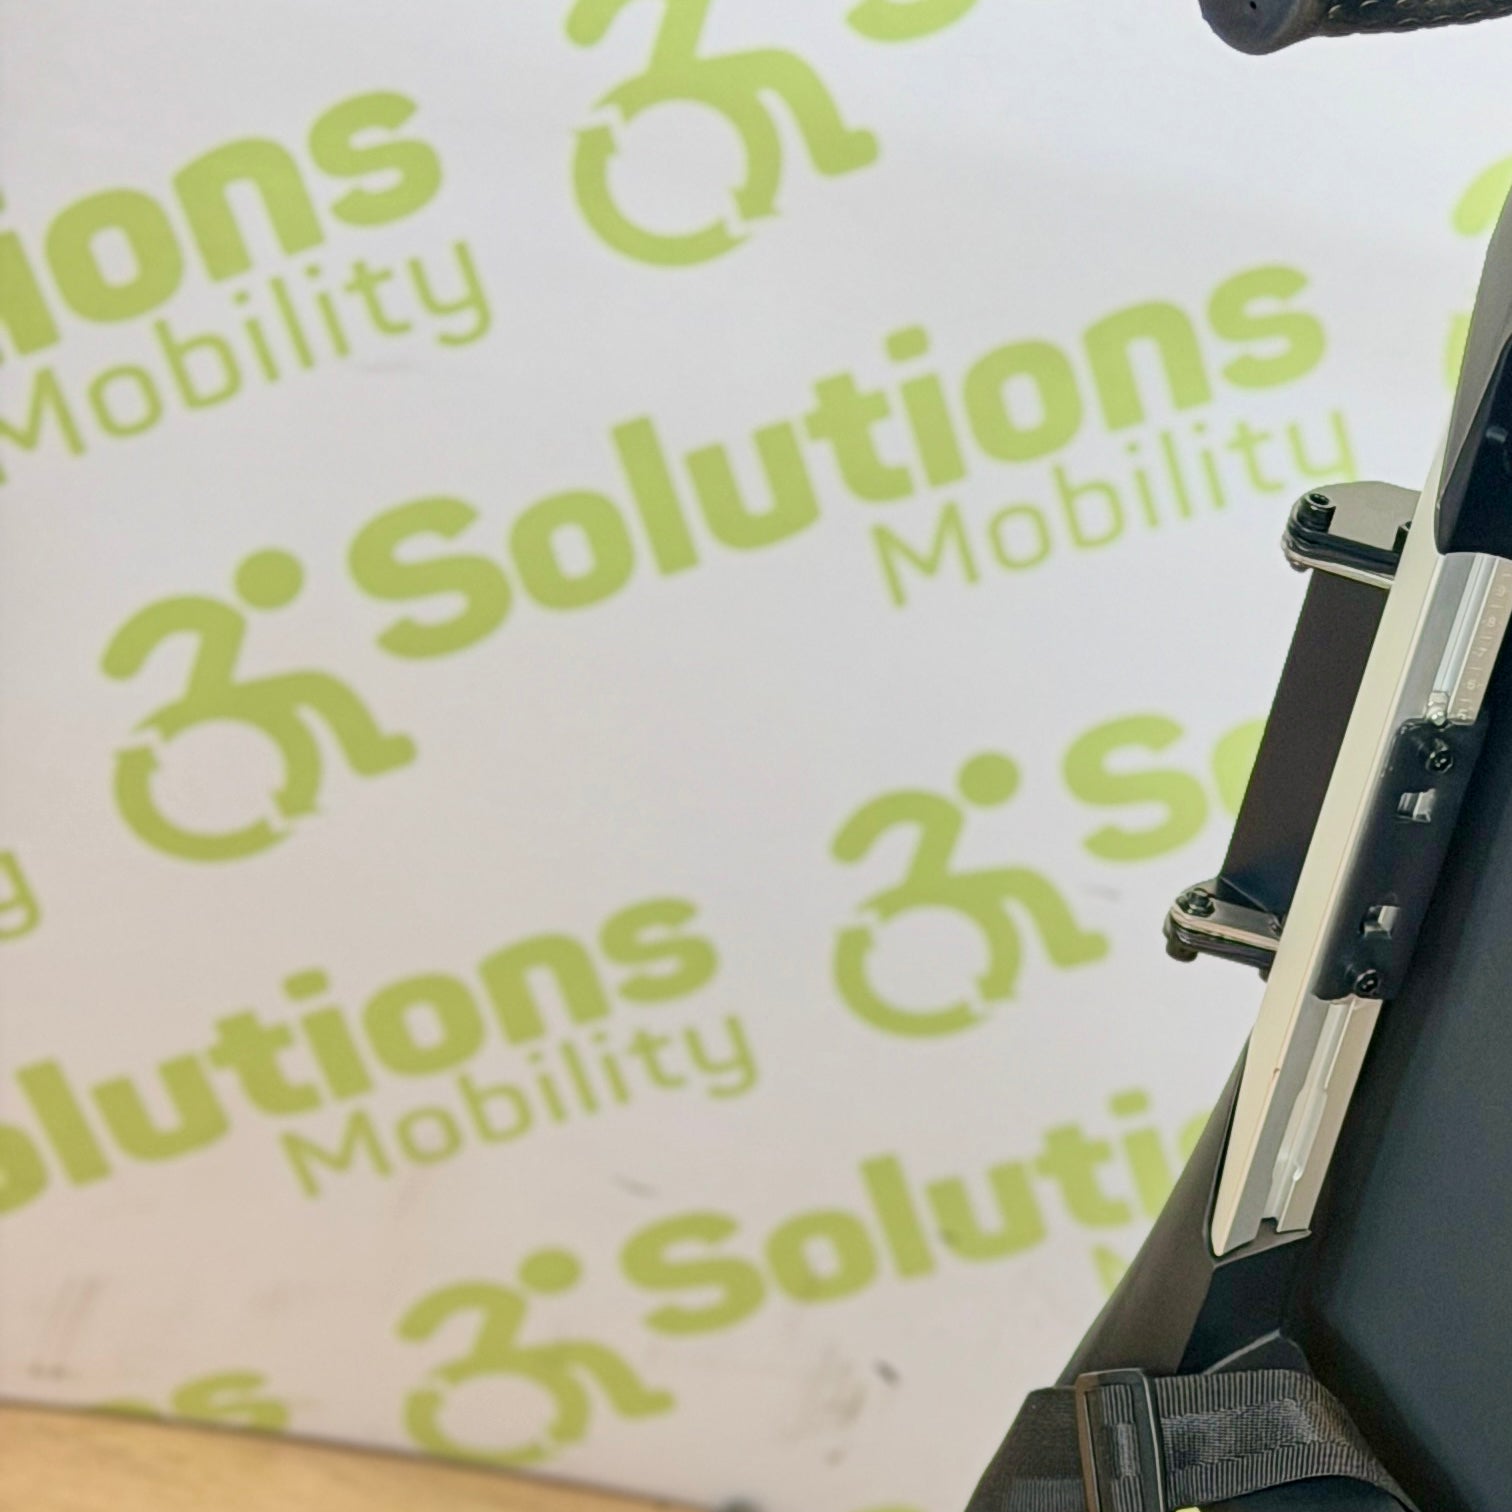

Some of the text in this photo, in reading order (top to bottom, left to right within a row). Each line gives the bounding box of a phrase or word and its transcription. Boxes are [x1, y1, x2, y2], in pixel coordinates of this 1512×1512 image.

[347, 263, 1327, 661] Solutions
[870, 408, 1358, 608] Mobility
[281, 1014, 759, 1198] Mobility
